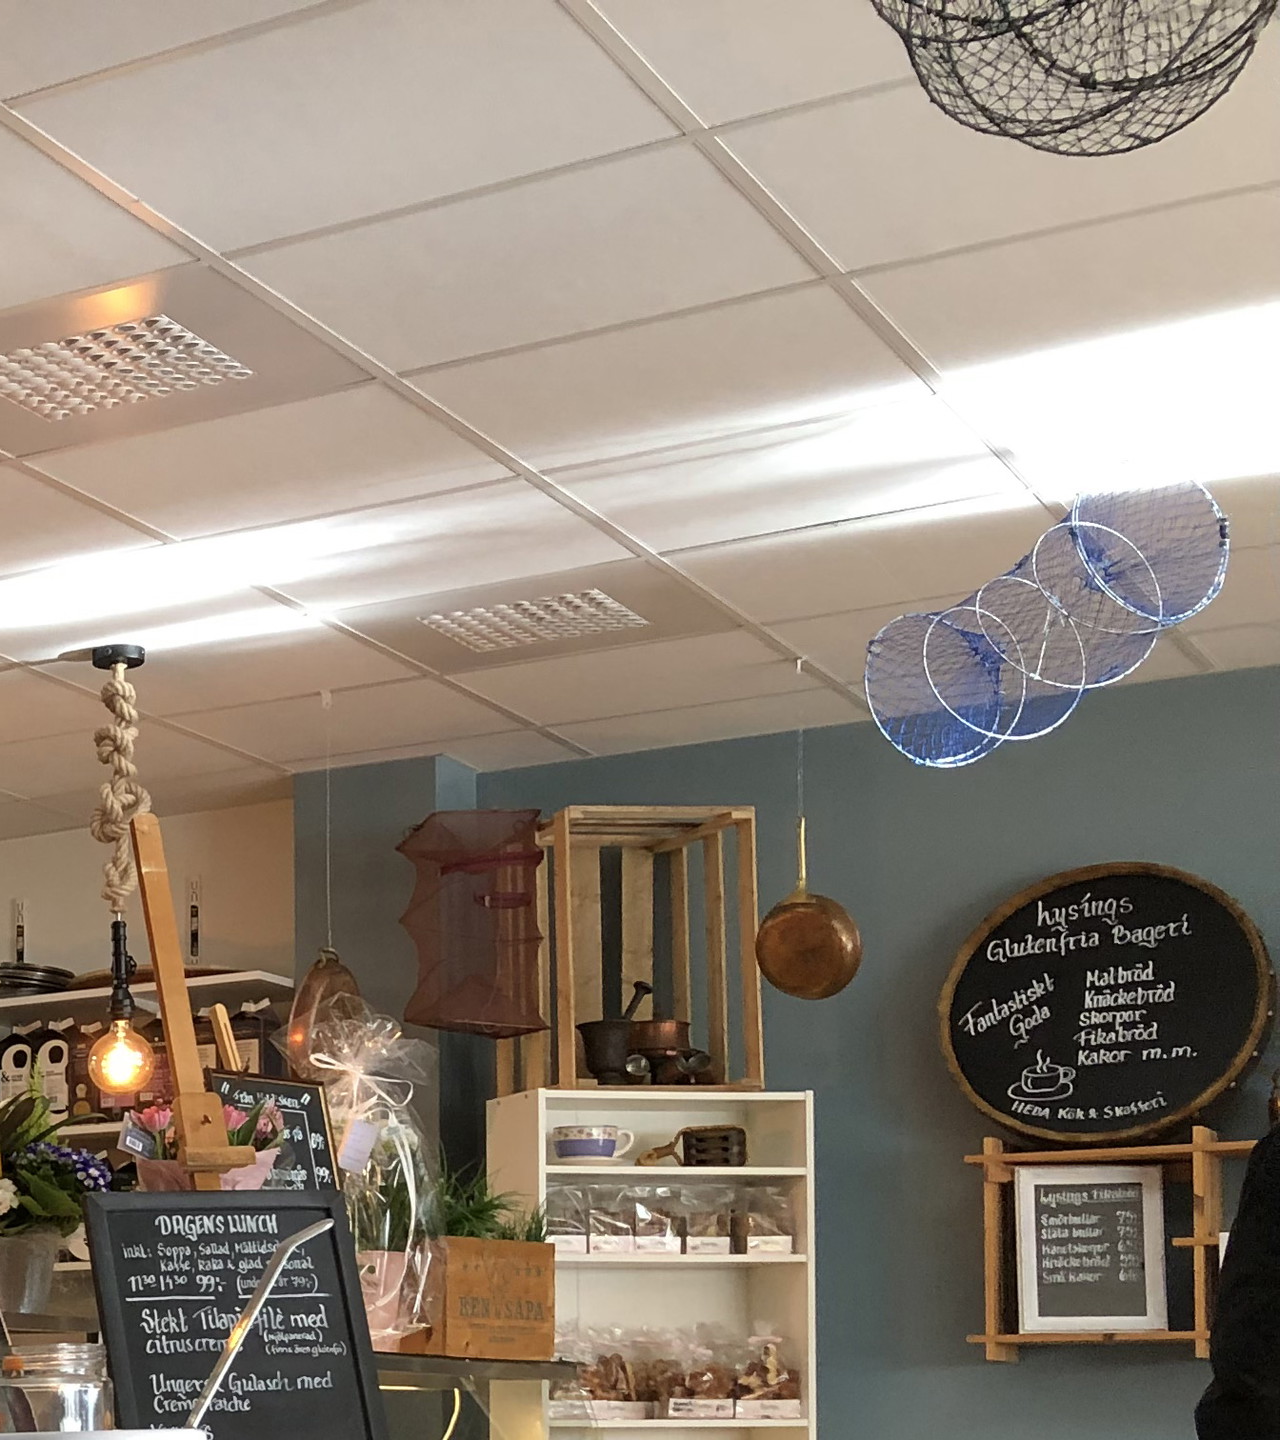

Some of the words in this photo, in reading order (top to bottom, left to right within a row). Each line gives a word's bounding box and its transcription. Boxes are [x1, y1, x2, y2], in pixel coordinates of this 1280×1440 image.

[986, 931, 1100, 963] Glutenfria
[1112, 913, 1192, 948] Bageri
[958, 972, 1055, 1036] Fantastiskt
[1084, 980, 1175, 1009] Knäckebröd
[1009, 1004, 1051, 1049] Goda
[1077, 1048, 1132, 1066] Kakor
[1011, 1100, 1050, 1120] HEDA
[1103, 1091, 1168, 1118] Skafferi
[155, 1214, 225, 1241] DAGENS
[228, 1214, 278, 1234] LUNCH
[238, 1258, 263, 1273] glad
[140, 1308, 189, 1334] Stekt
[290, 1304, 329, 1328] med
[228, 1371, 294, 1395] Gulasch
[296, 1371, 333, 1390] med
